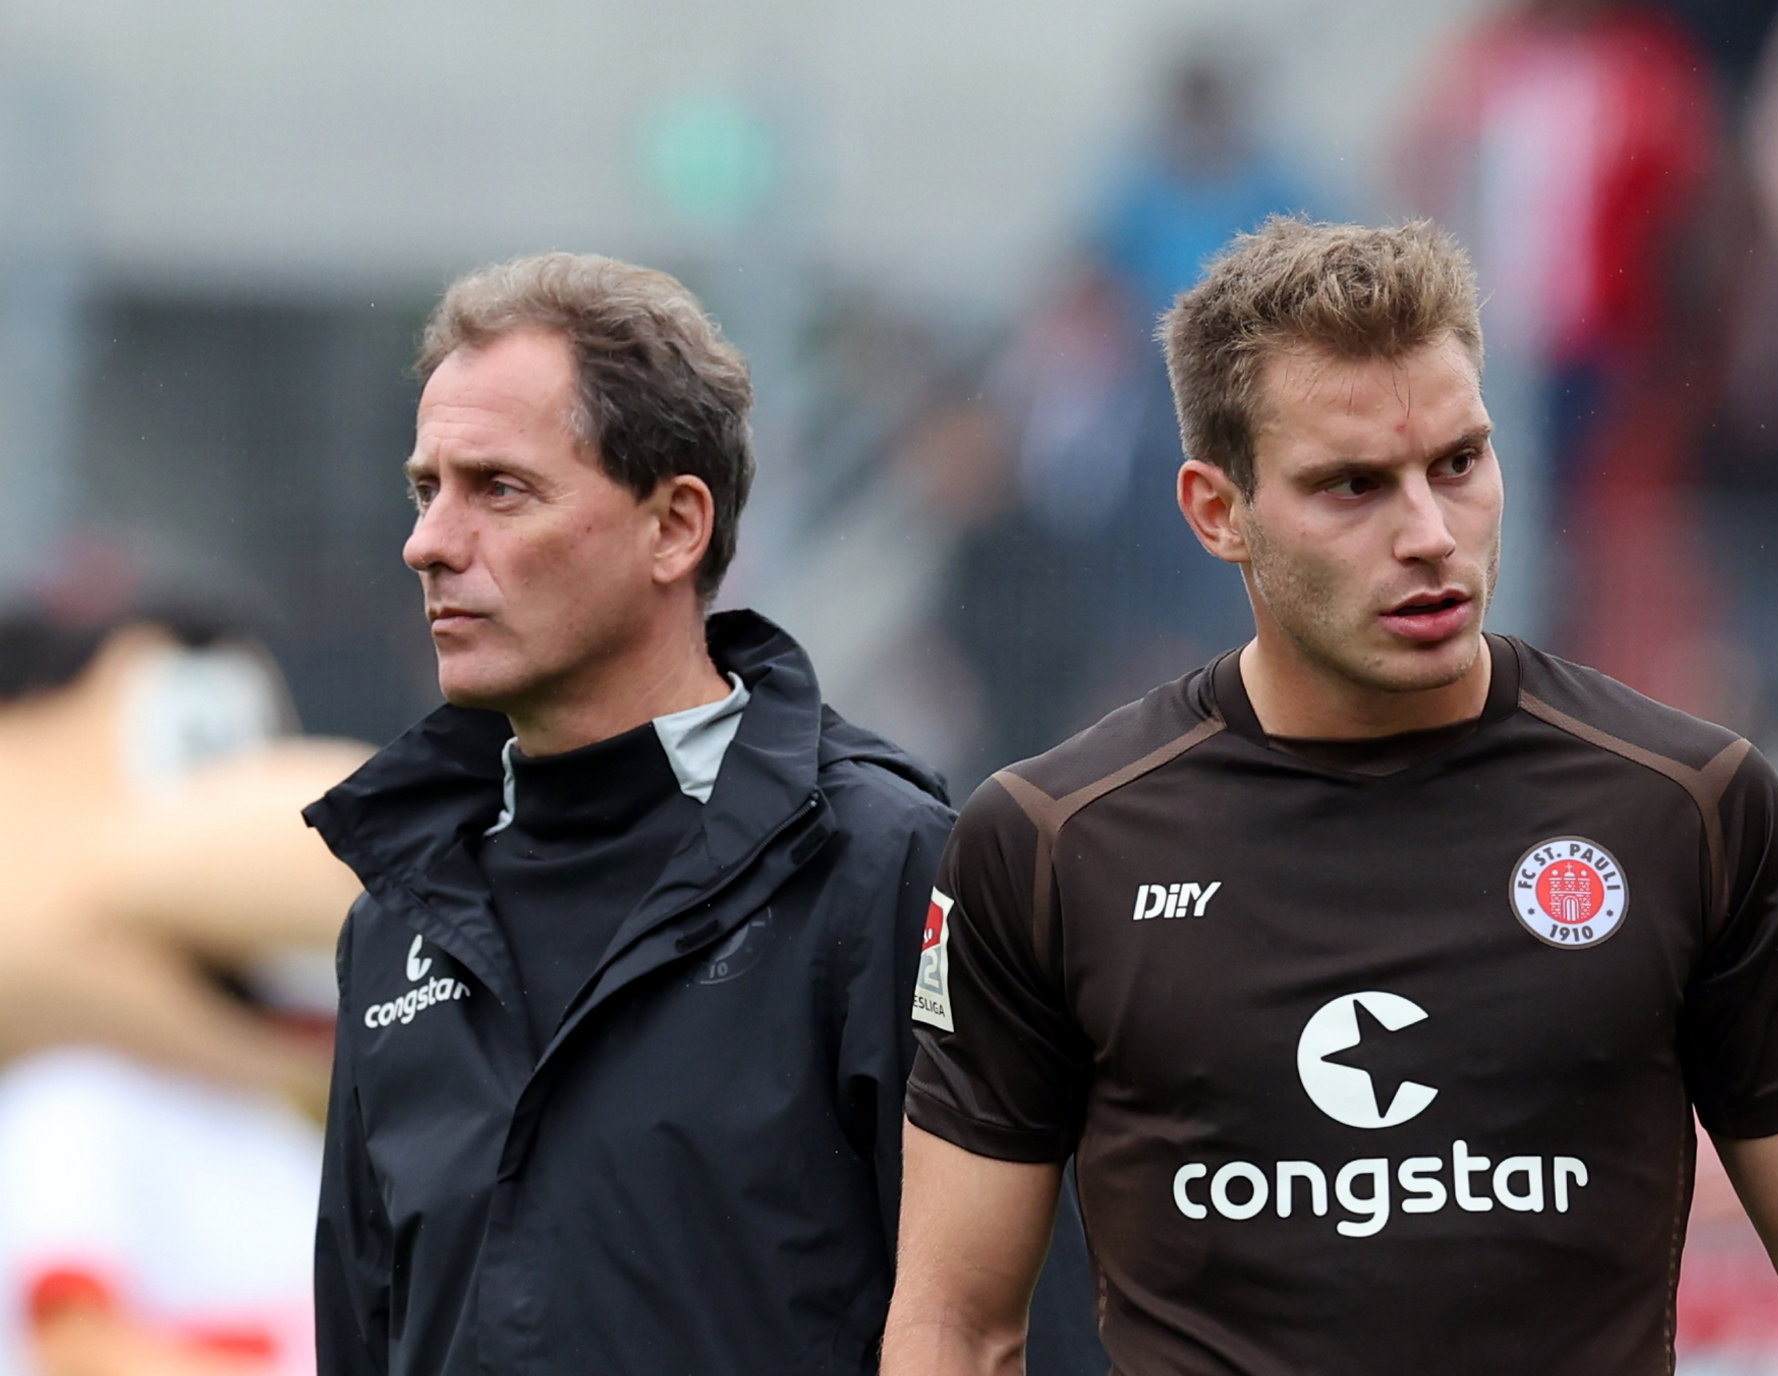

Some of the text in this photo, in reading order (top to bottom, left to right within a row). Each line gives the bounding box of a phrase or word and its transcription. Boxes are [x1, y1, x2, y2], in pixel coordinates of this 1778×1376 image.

[1518, 843, 1621, 891] FC ST. PAULI
[1549, 923, 1594, 942] 1910
[364, 976, 471, 1029] congstar
[913, 995, 946, 1018] ESLIGA
[1173, 1139, 1588, 1238] congstar
